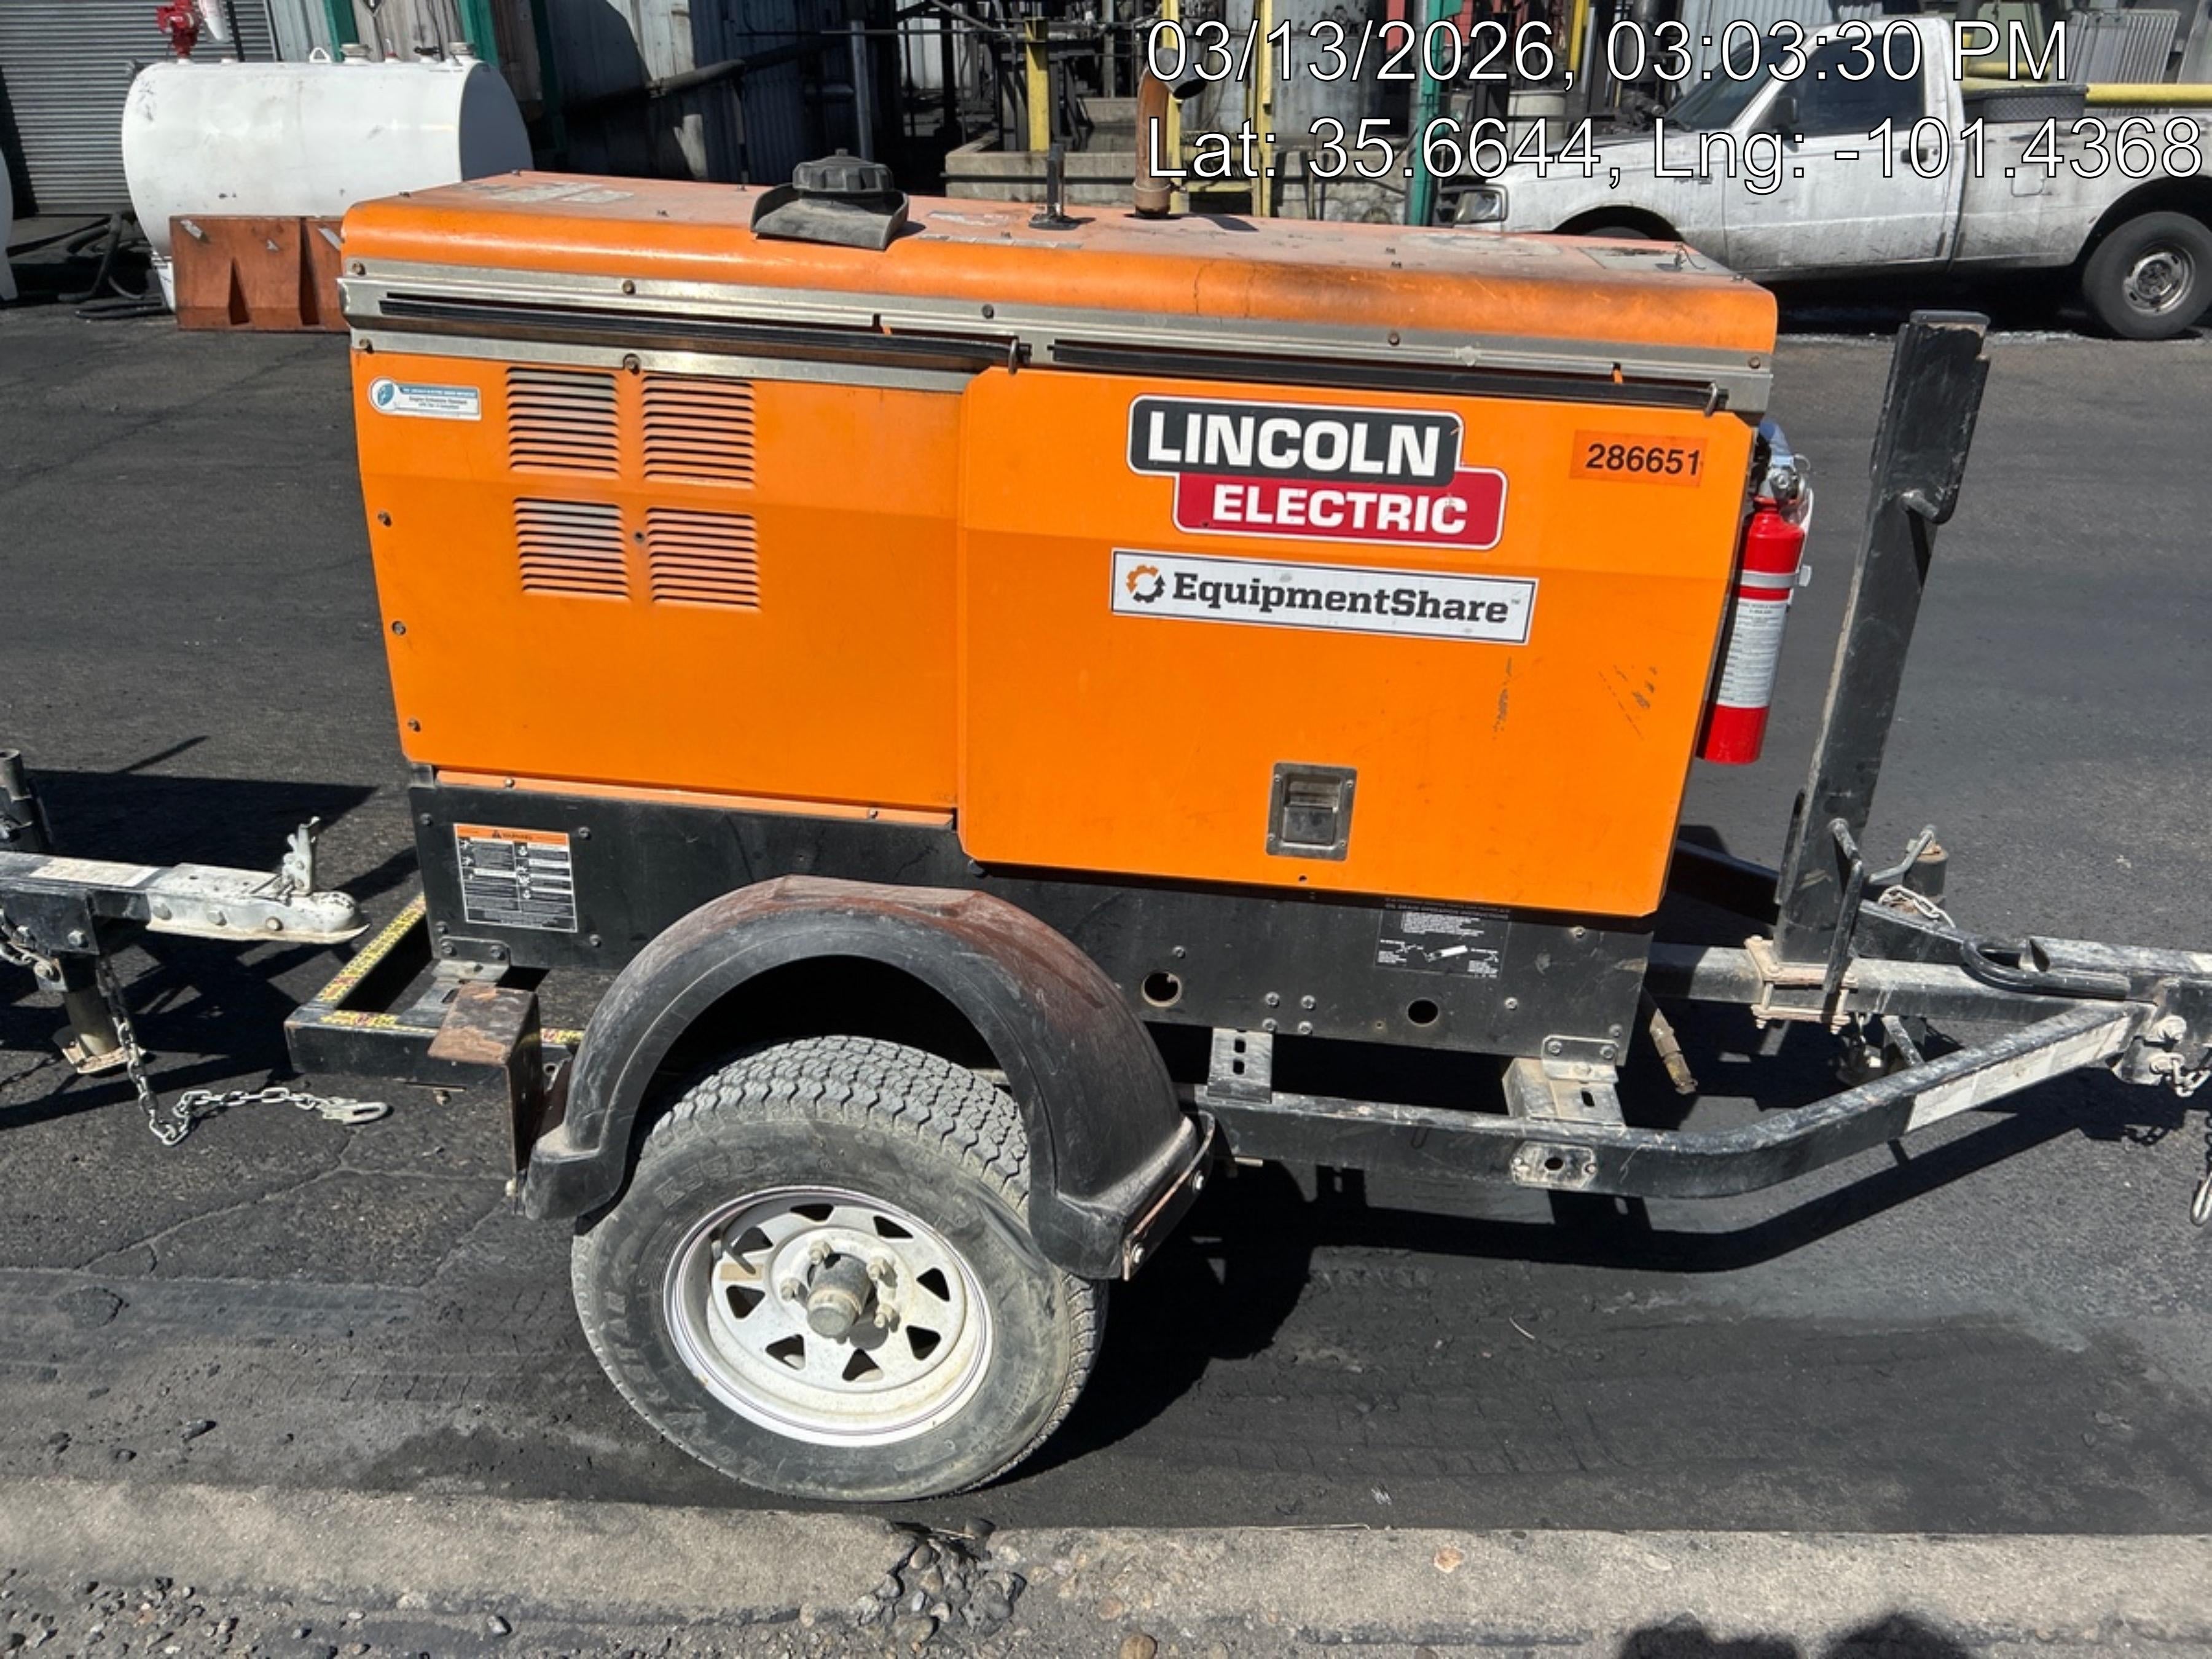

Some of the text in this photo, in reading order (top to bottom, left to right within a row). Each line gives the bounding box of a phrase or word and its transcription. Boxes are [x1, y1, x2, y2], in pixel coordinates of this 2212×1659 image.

[1147, 410, 1441, 477] LINCOLN
[1585, 442, 1703, 477] 286651
[1212, 484, 1468, 534] ELECTRIC
[1172, 572, 1509, 624] EquipmentShare
